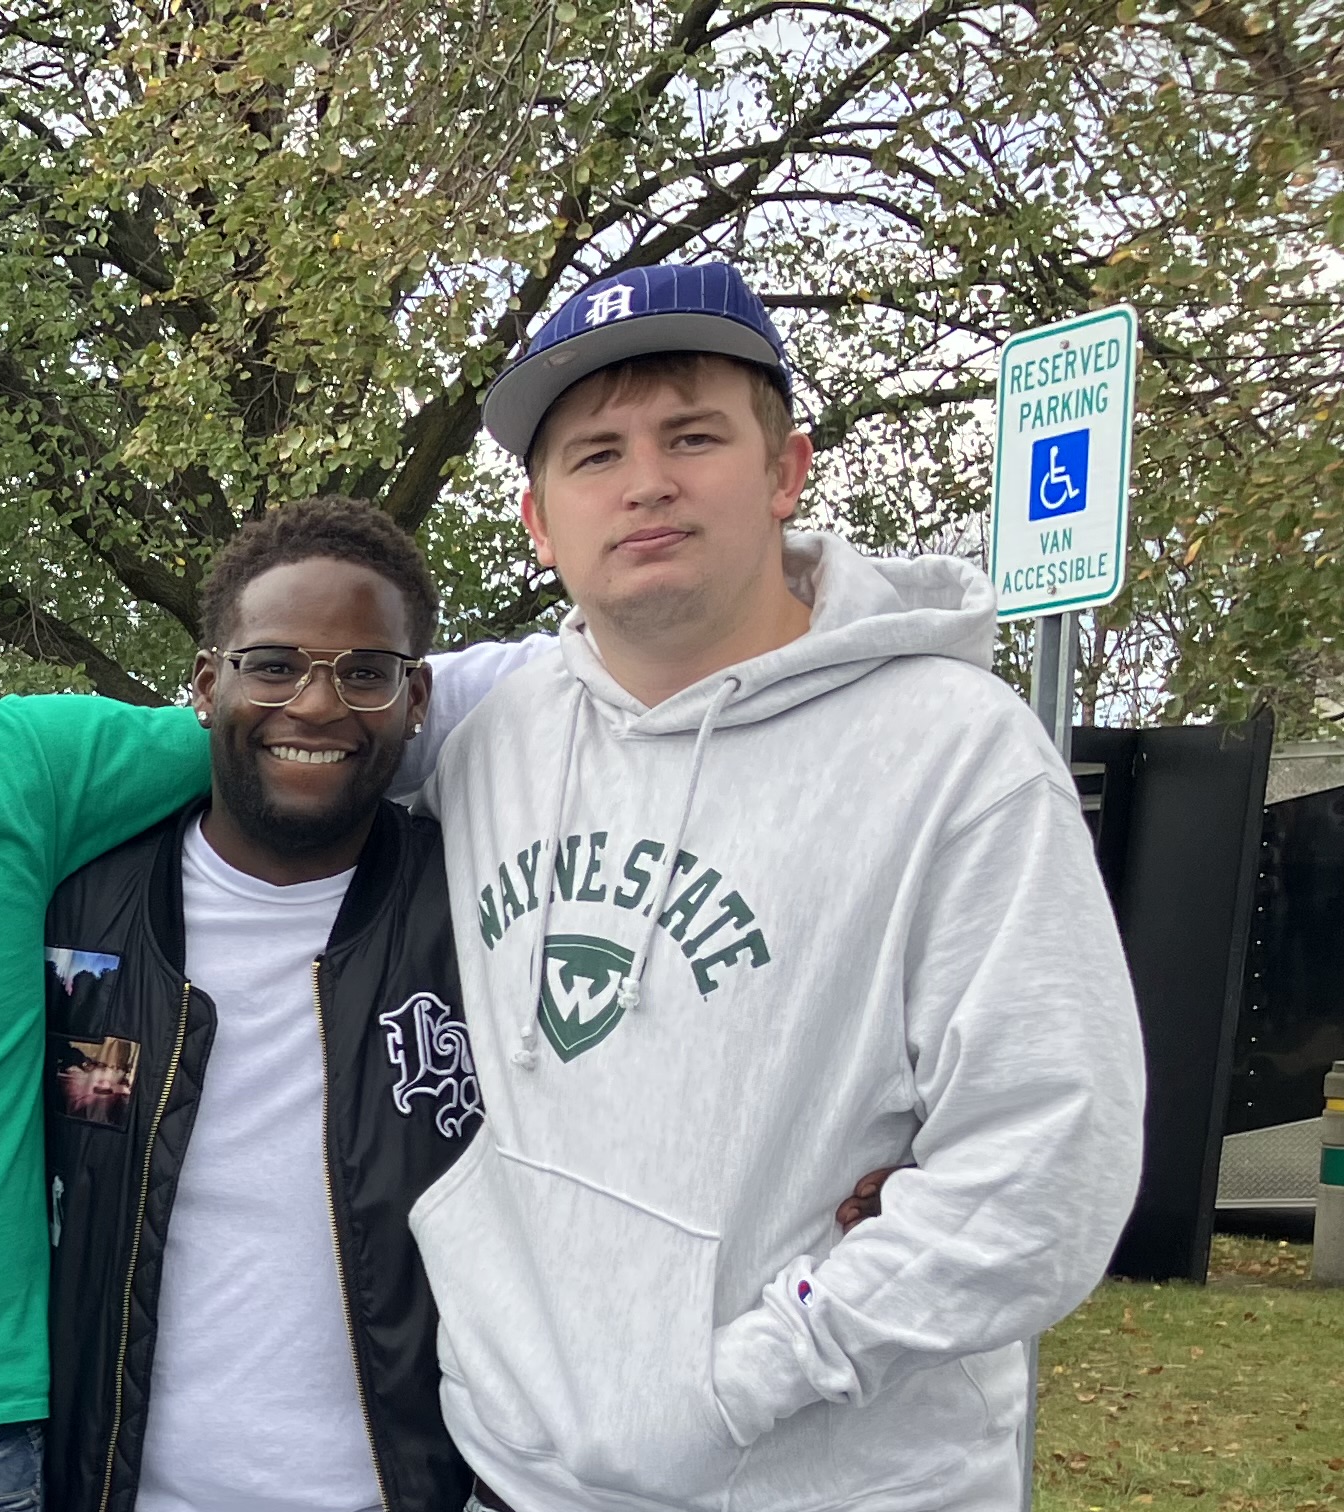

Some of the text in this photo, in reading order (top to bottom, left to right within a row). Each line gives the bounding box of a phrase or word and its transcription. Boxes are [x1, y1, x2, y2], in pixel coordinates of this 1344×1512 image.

[1009, 338, 1120, 395] RESERVED
[1018, 382, 1109, 433] PARKING
[1039, 527, 1073, 556] VAN
[1001, 552, 1108, 595] ACCESSIBLE
[478, 831, 771, 995] WAYNE STATE
